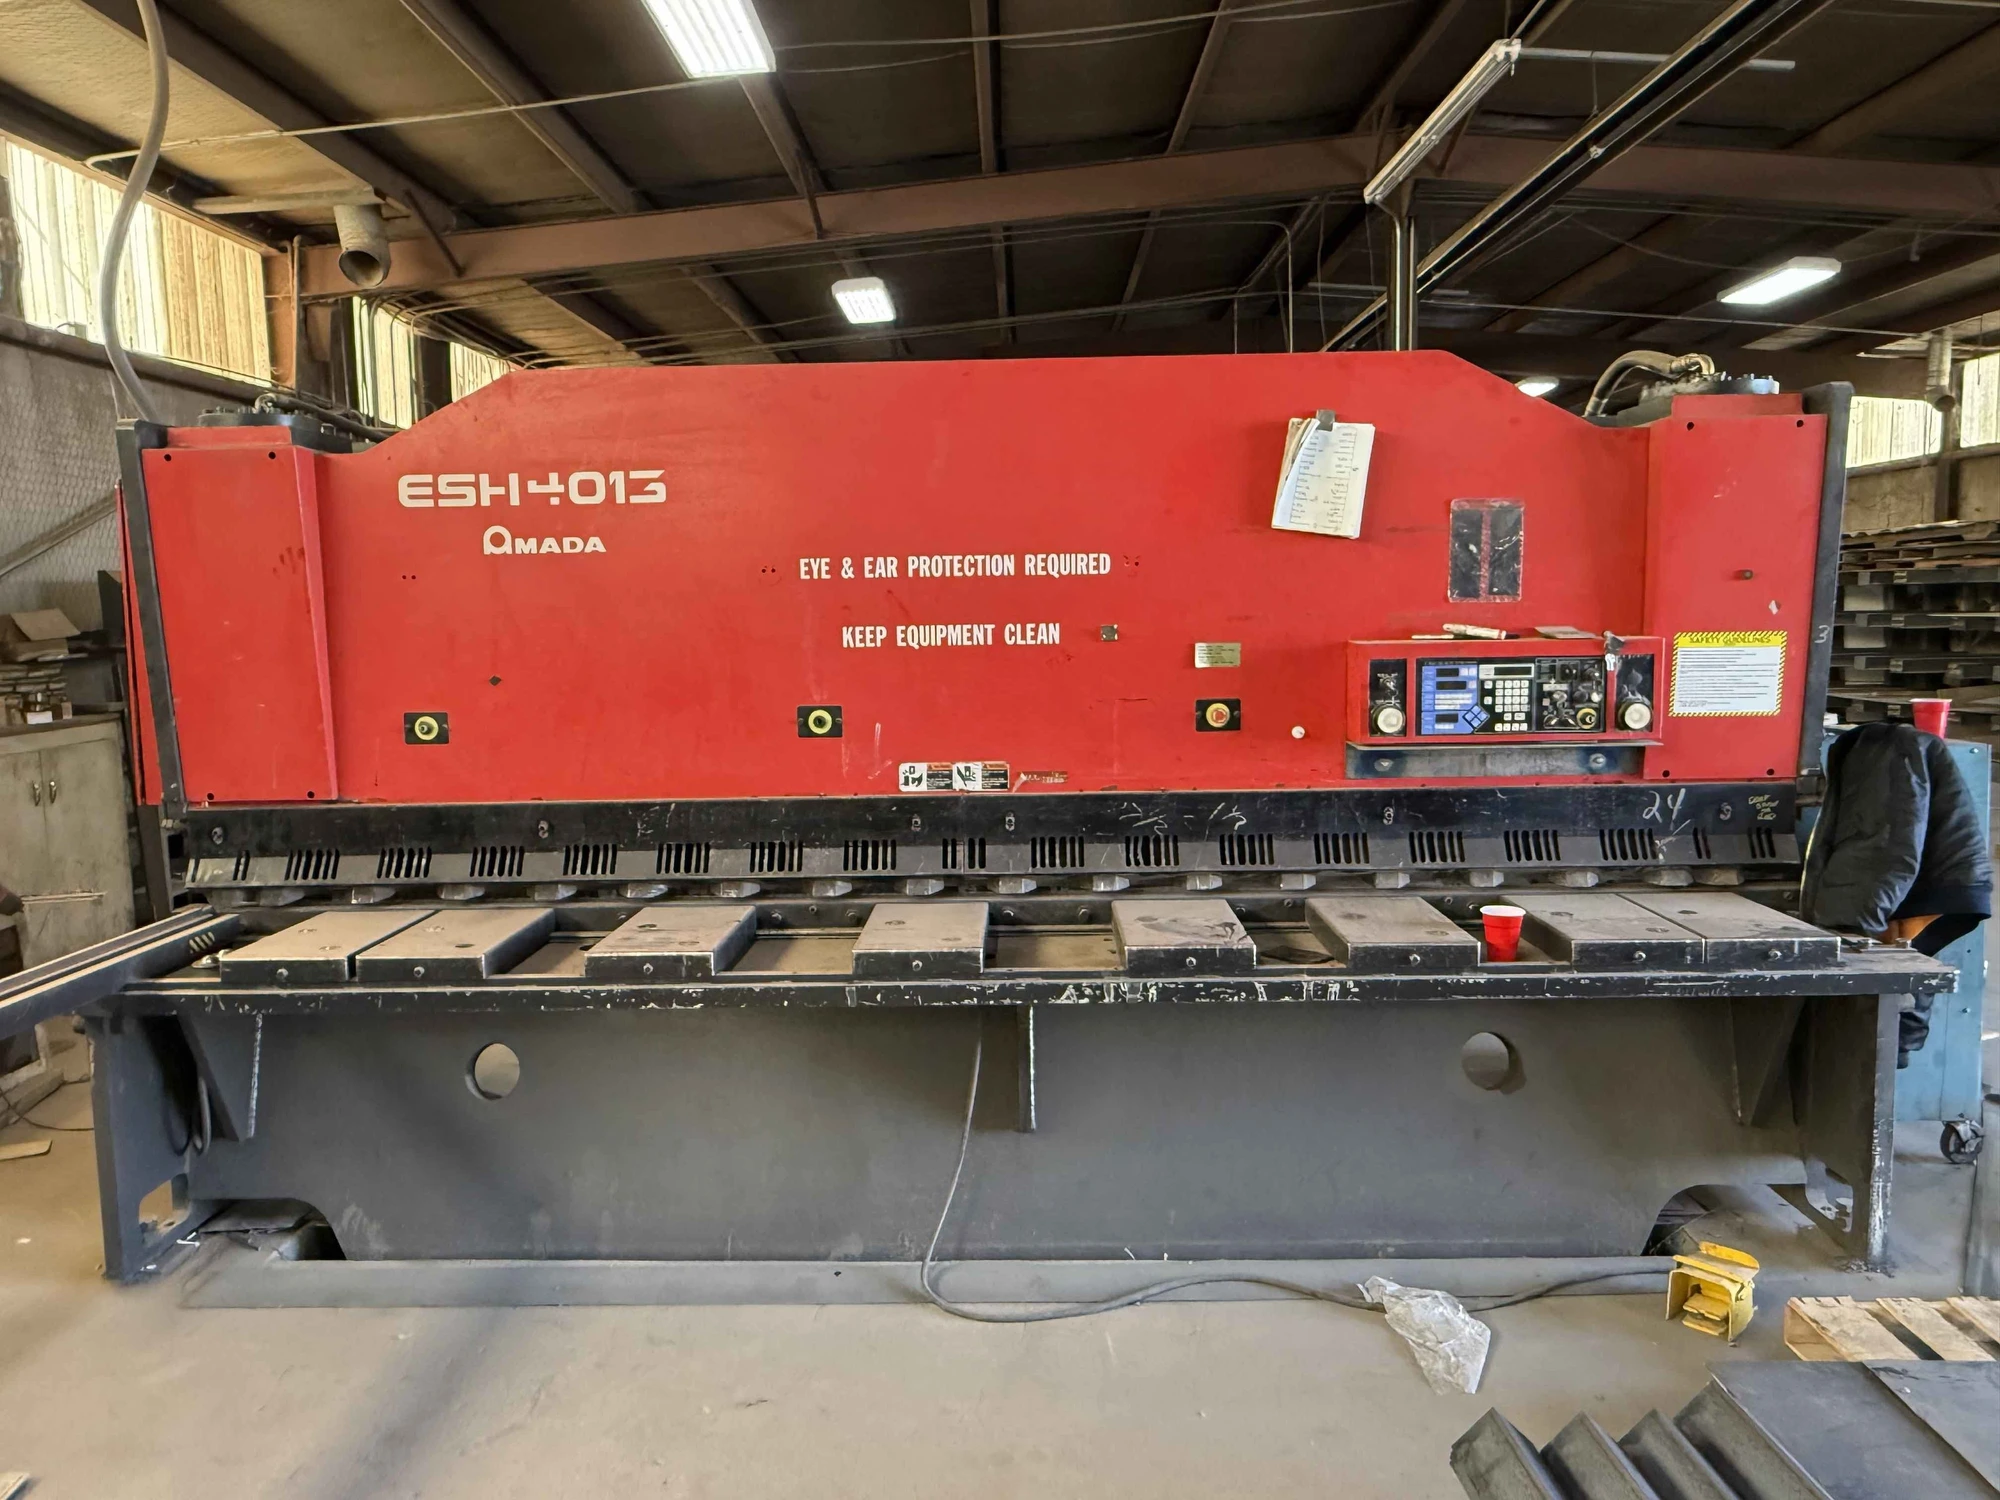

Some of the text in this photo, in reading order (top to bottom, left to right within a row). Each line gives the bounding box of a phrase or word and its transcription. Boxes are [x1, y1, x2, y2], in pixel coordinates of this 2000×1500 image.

[483, 525, 607, 555] AMADA
[799, 553, 1111, 580] EYE & EAR PROTECTION REQUIRED
[841, 622, 1061, 650] KEEP EQUIPMENT CLEAN
[1643, 788, 1686, 828] 24
